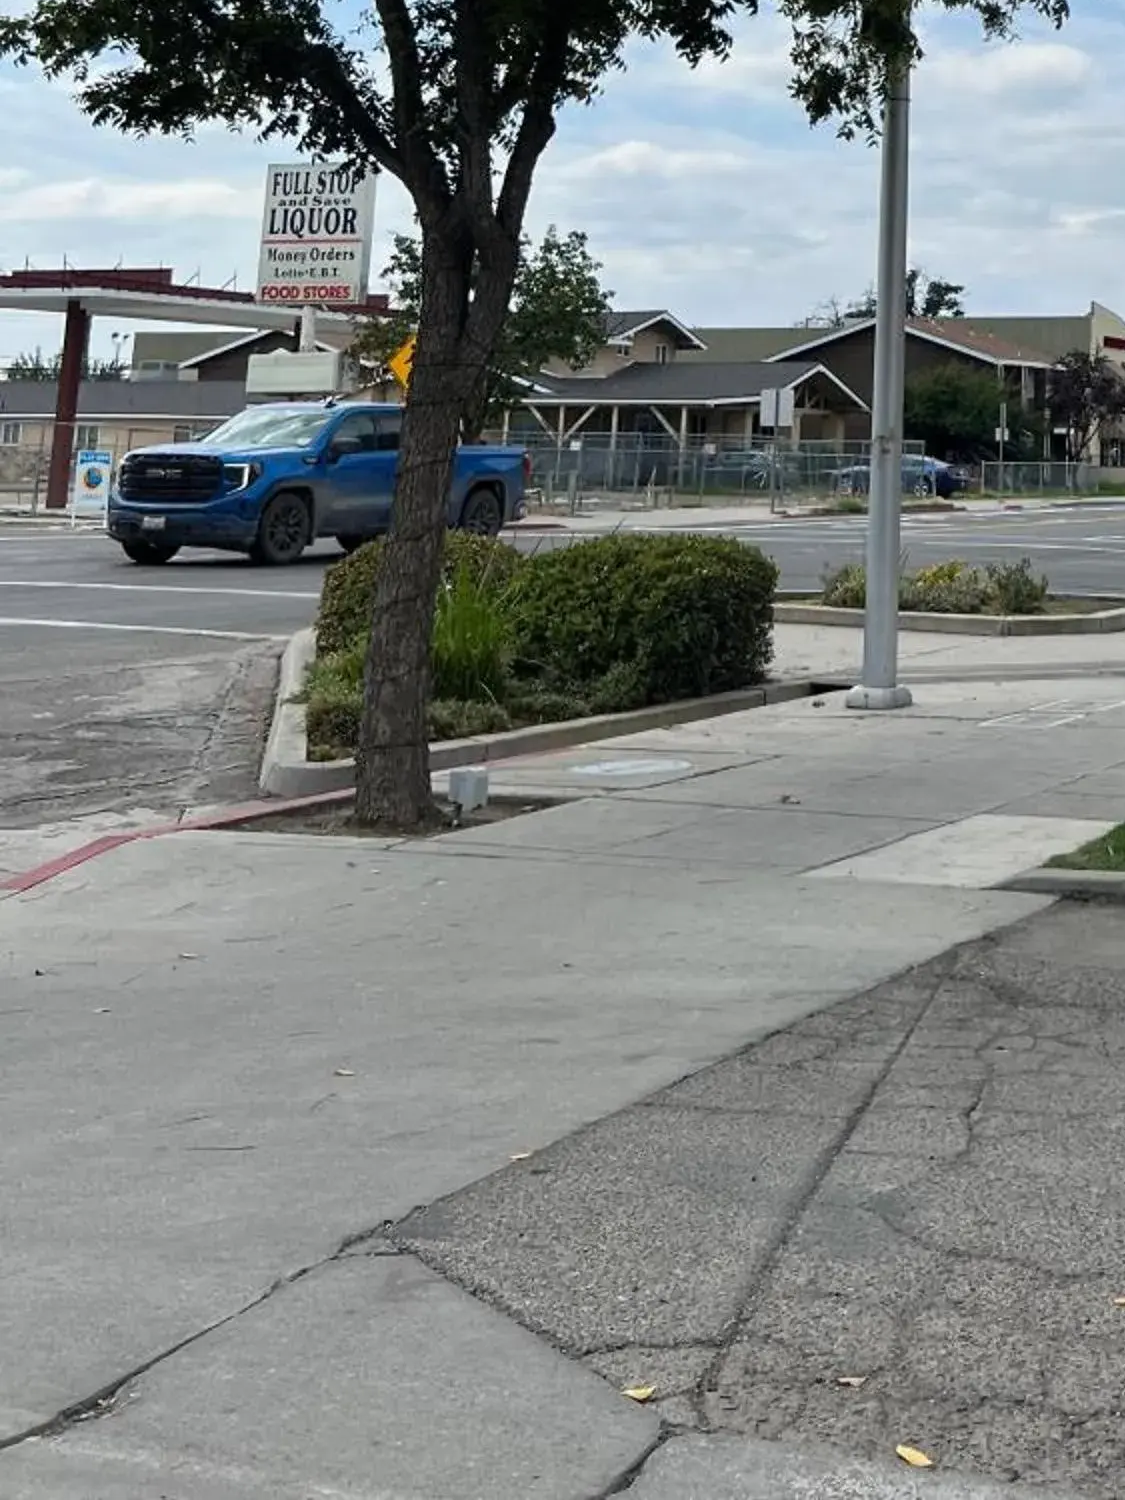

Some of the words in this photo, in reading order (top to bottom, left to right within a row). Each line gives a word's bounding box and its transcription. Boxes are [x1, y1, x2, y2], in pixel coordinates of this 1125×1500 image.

[272, 171, 313, 196] FULL
[315, 170, 361, 194] STOP
[278, 195, 308, 207] and
[312, 195, 351, 206] Save
[269, 207, 358, 239] LIQUOR
[267, 248, 306, 264] Money
[309, 247, 355, 261] Orders
[261, 285, 300, 300] FOOD
[303, 285, 351, 299] STORES
